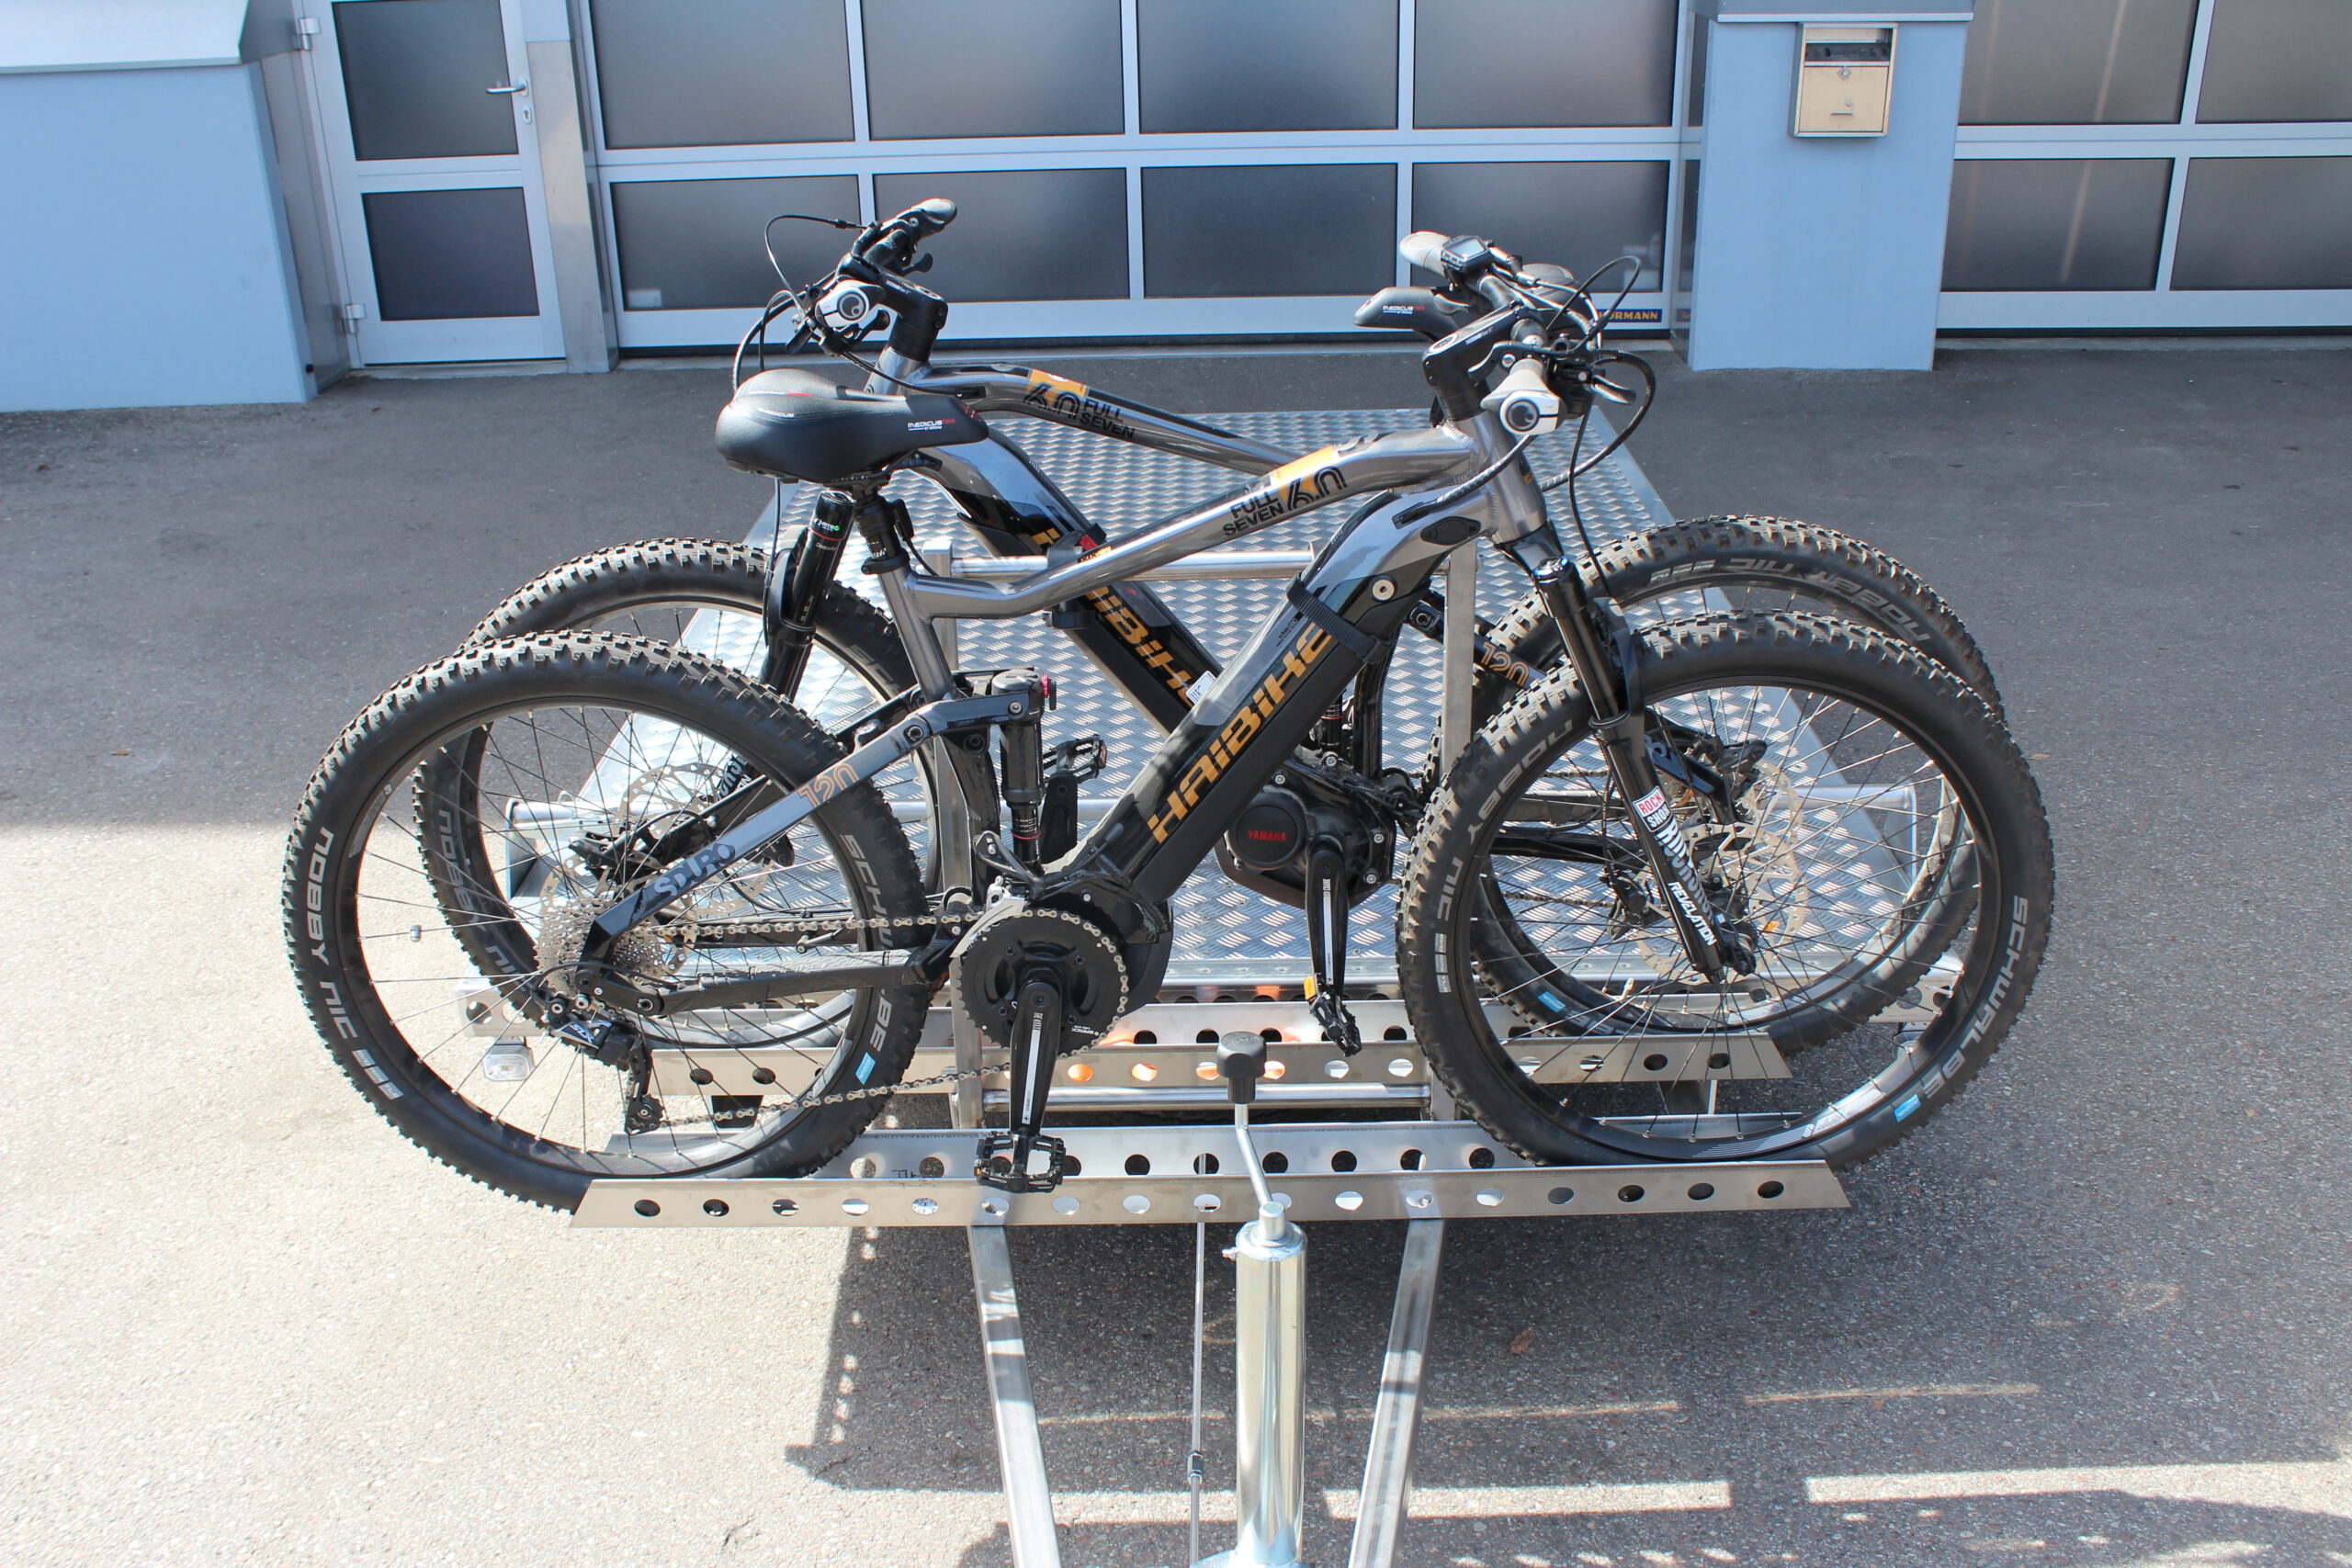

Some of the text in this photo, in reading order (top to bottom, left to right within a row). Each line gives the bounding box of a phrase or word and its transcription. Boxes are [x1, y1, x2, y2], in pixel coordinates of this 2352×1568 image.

[908, 420, 943, 429] MEDICUS
[1080, 412, 1136, 438] SEVEN
[1084, 398, 1124, 423] FULL
[1223, 502, 1284, 536] SEVEN
[1230, 491, 1279, 519] FULL
[1728, 558, 1793, 573] NIC
[1481, 641, 1530, 686] 120
[1148, 621, 1332, 844] HAIBIKE
[798, 762, 860, 808] 120
[1638, 791, 1664, 815] ROCK
[1646, 803, 1671, 829] SHOX
[1249, 830, 1287, 840] YAMAHA
[1437, 719, 1573, 921] NOBBY NIC
[653, 842, 733, 897] SDURO
[1668, 881, 1717, 946] REVELATION
[307, 827, 358, 1040] NOBBY NIC
[1923, 895, 2030, 1100] SCHWALBE
[570, 1023, 595, 1043] SLX
